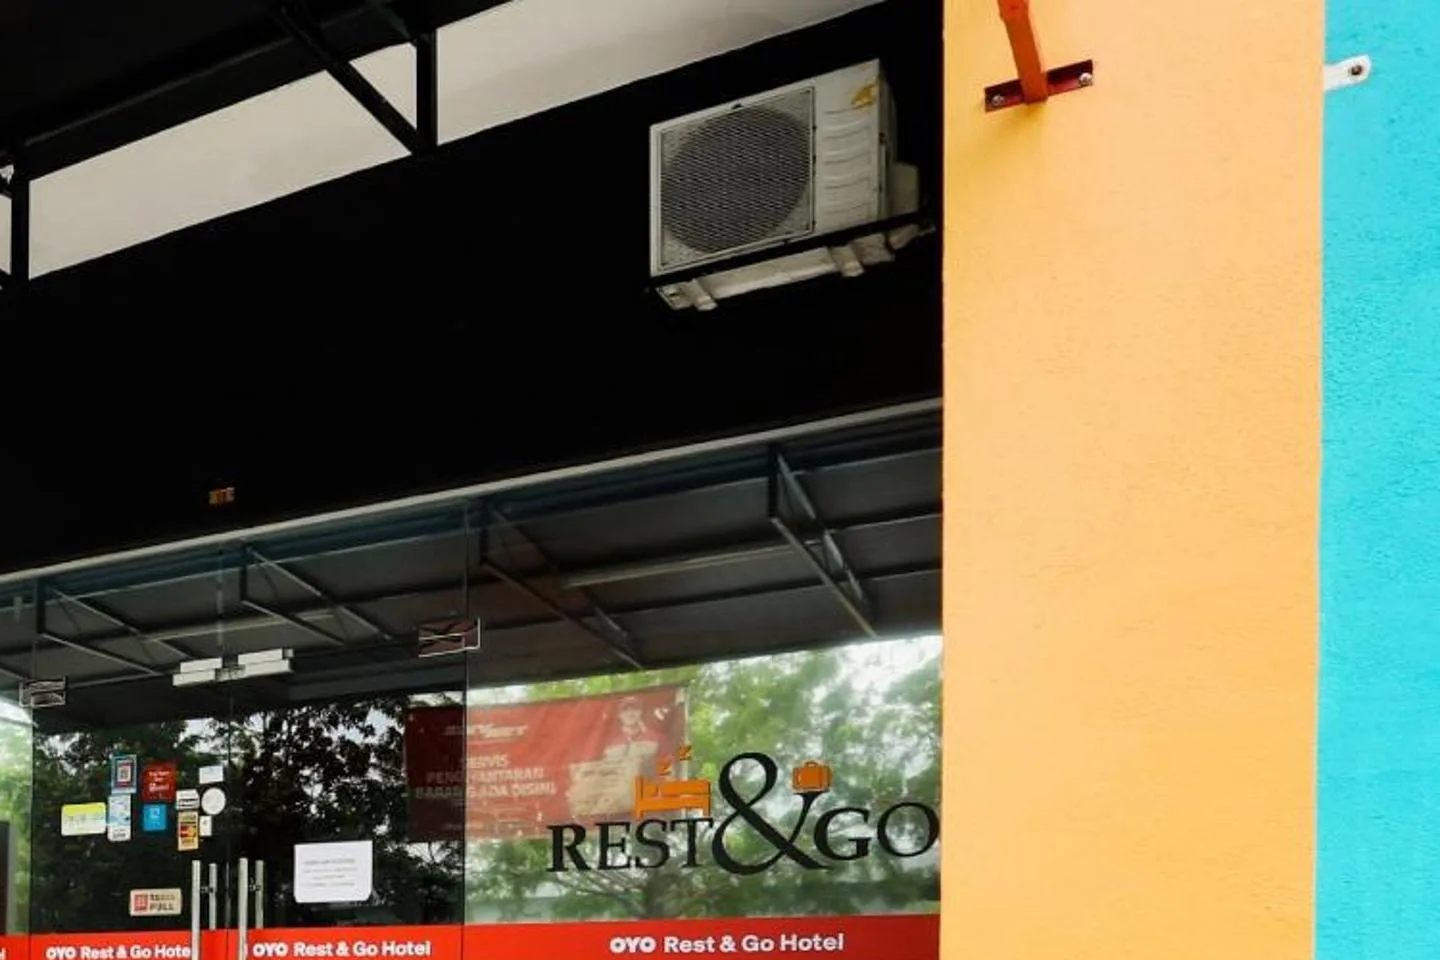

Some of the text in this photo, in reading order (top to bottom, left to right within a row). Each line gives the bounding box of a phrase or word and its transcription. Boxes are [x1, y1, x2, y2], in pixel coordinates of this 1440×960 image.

[456, 754, 510, 769] ERVIS
[46, 943, 192, 960] OYO Rest & Go Hote
[252, 939, 432, 958] OYO Rest & Go Hotel
[610, 931, 845, 955] OYO Rest & Go Hotel
